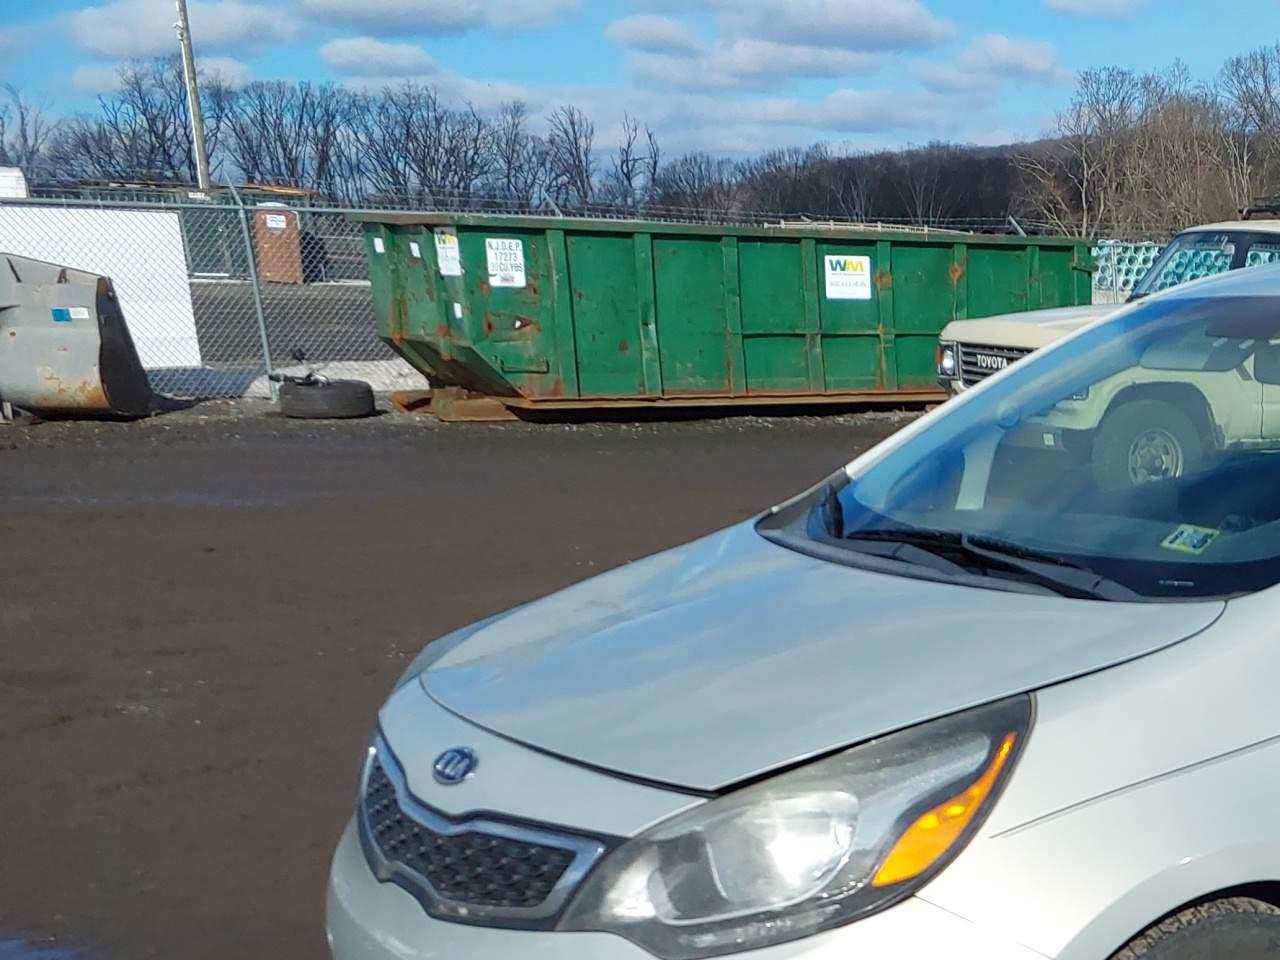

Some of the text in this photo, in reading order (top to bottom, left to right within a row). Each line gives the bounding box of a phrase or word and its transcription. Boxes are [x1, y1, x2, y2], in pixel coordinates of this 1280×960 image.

[494, 252, 518, 262] 17273
[828, 258, 865, 272] WM
[976, 354, 1008, 369] TOYOTA
